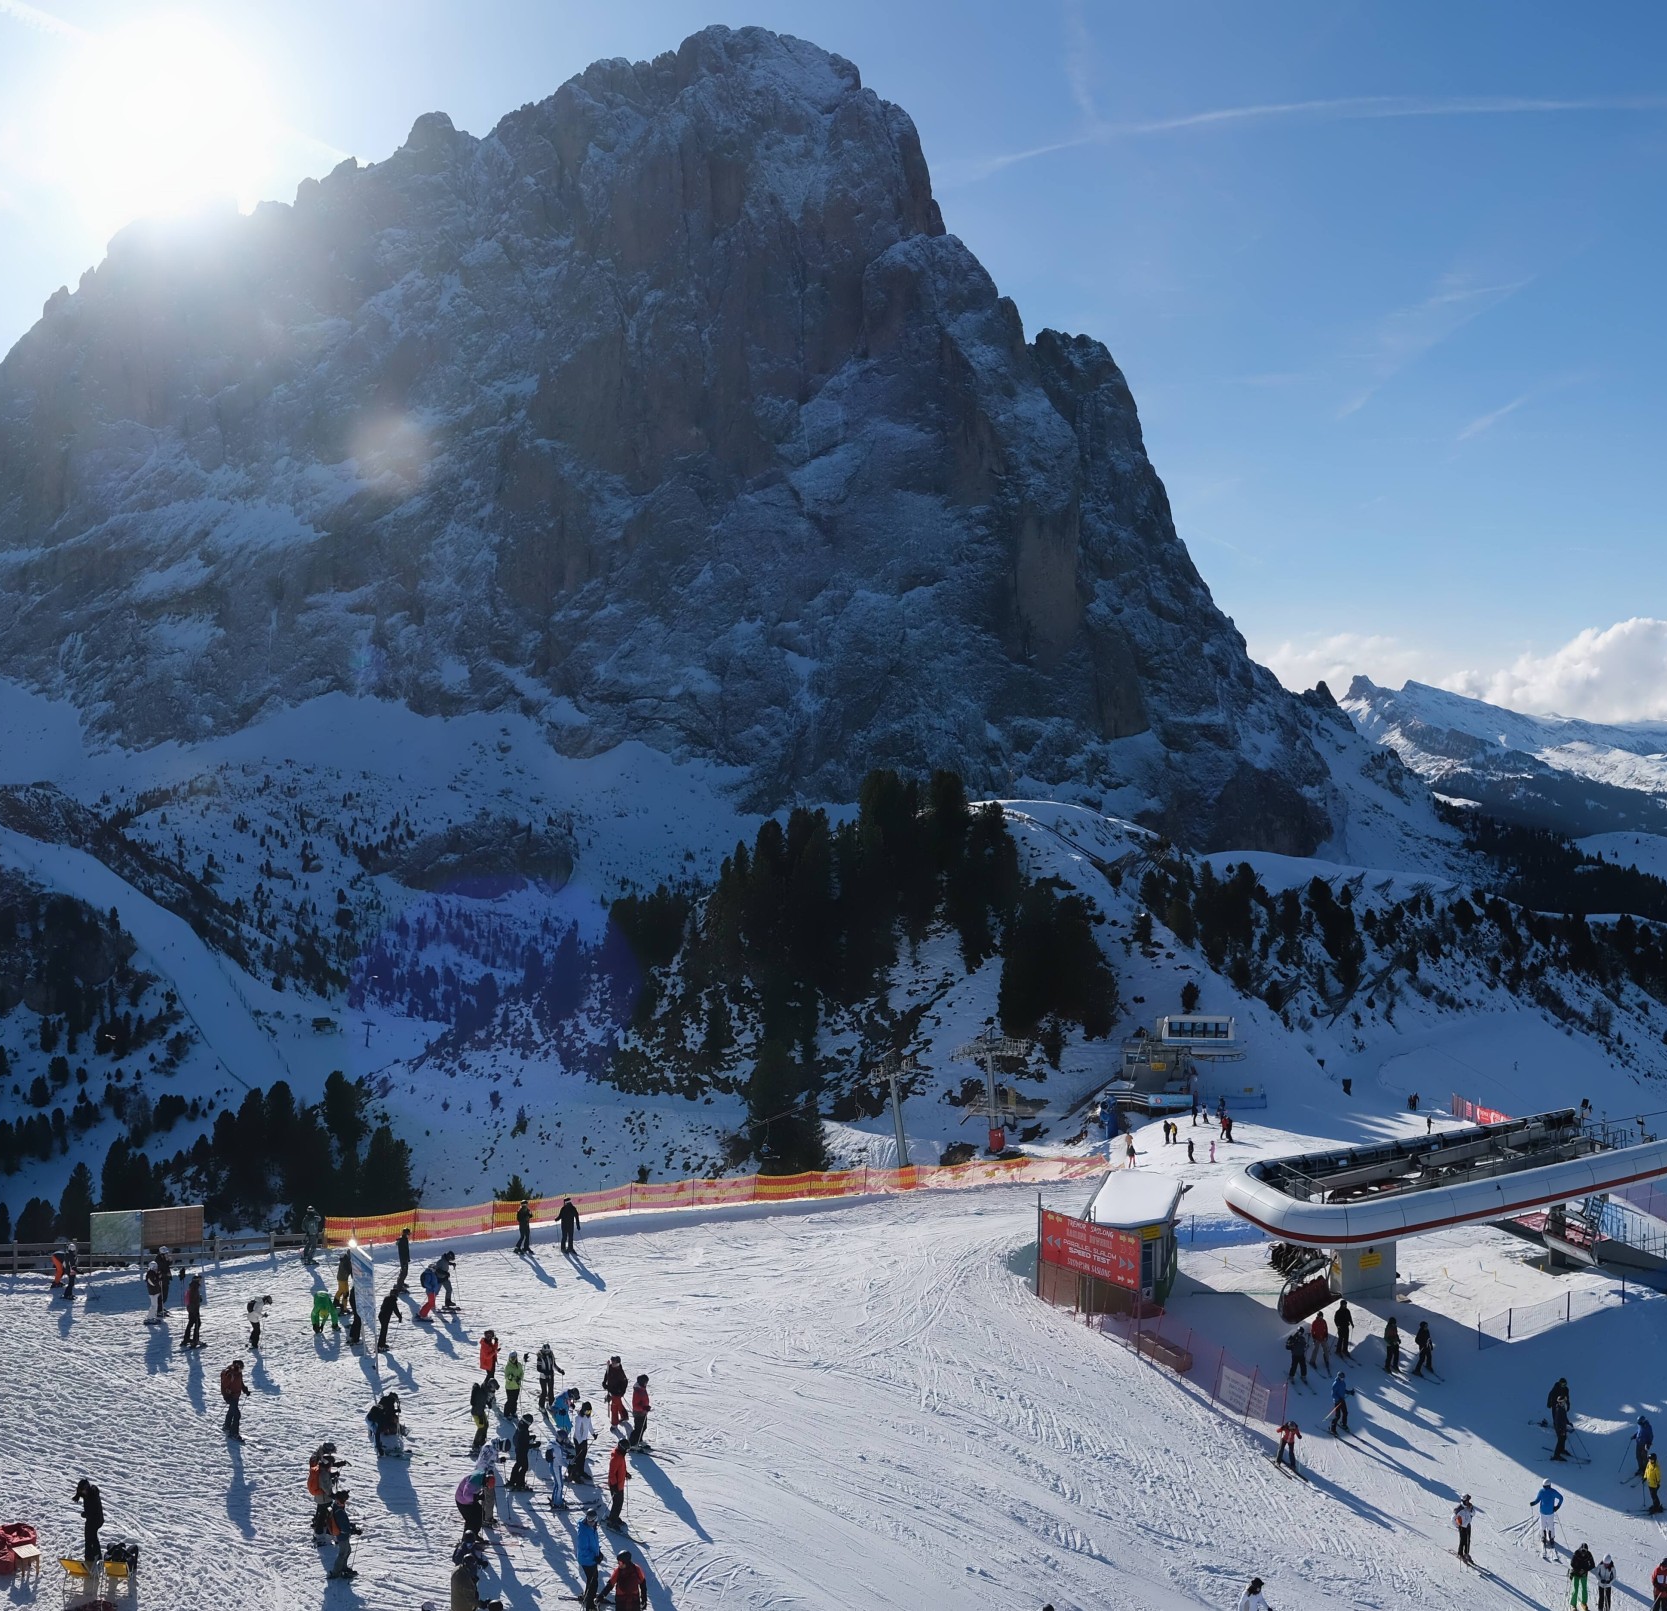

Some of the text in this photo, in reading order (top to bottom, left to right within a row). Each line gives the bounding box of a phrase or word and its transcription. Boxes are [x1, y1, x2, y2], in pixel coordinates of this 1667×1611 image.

[1067, 1219, 1114, 1239] TREMOR SASLONG
[1063, 1239, 1117, 1260] PARALLEL SLALOM
[1068, 1247, 1111, 1265] SPEED TEST
